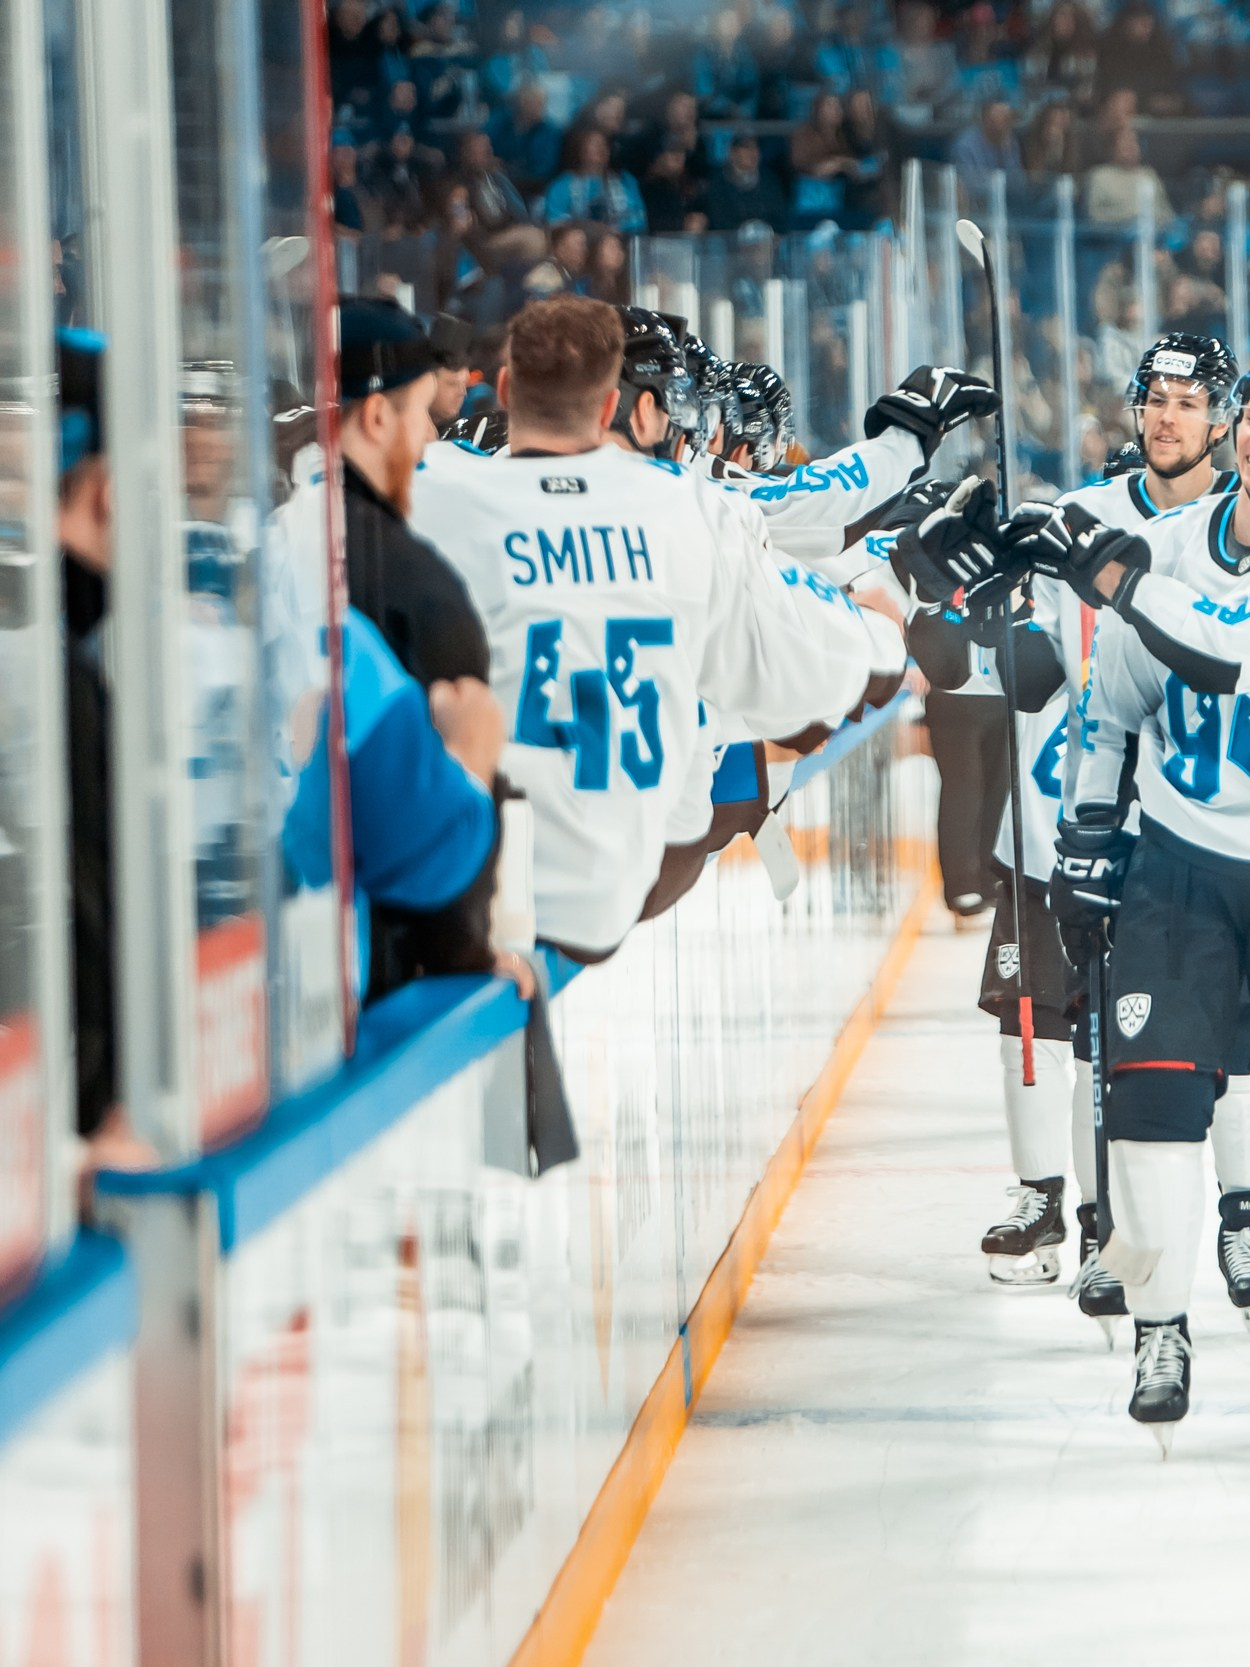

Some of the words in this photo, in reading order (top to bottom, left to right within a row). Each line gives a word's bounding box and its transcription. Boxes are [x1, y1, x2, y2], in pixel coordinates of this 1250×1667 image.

[504, 525, 653, 586] SMITH
[514, 616, 674, 791] 45
[1056, 853, 1127, 879] CM
